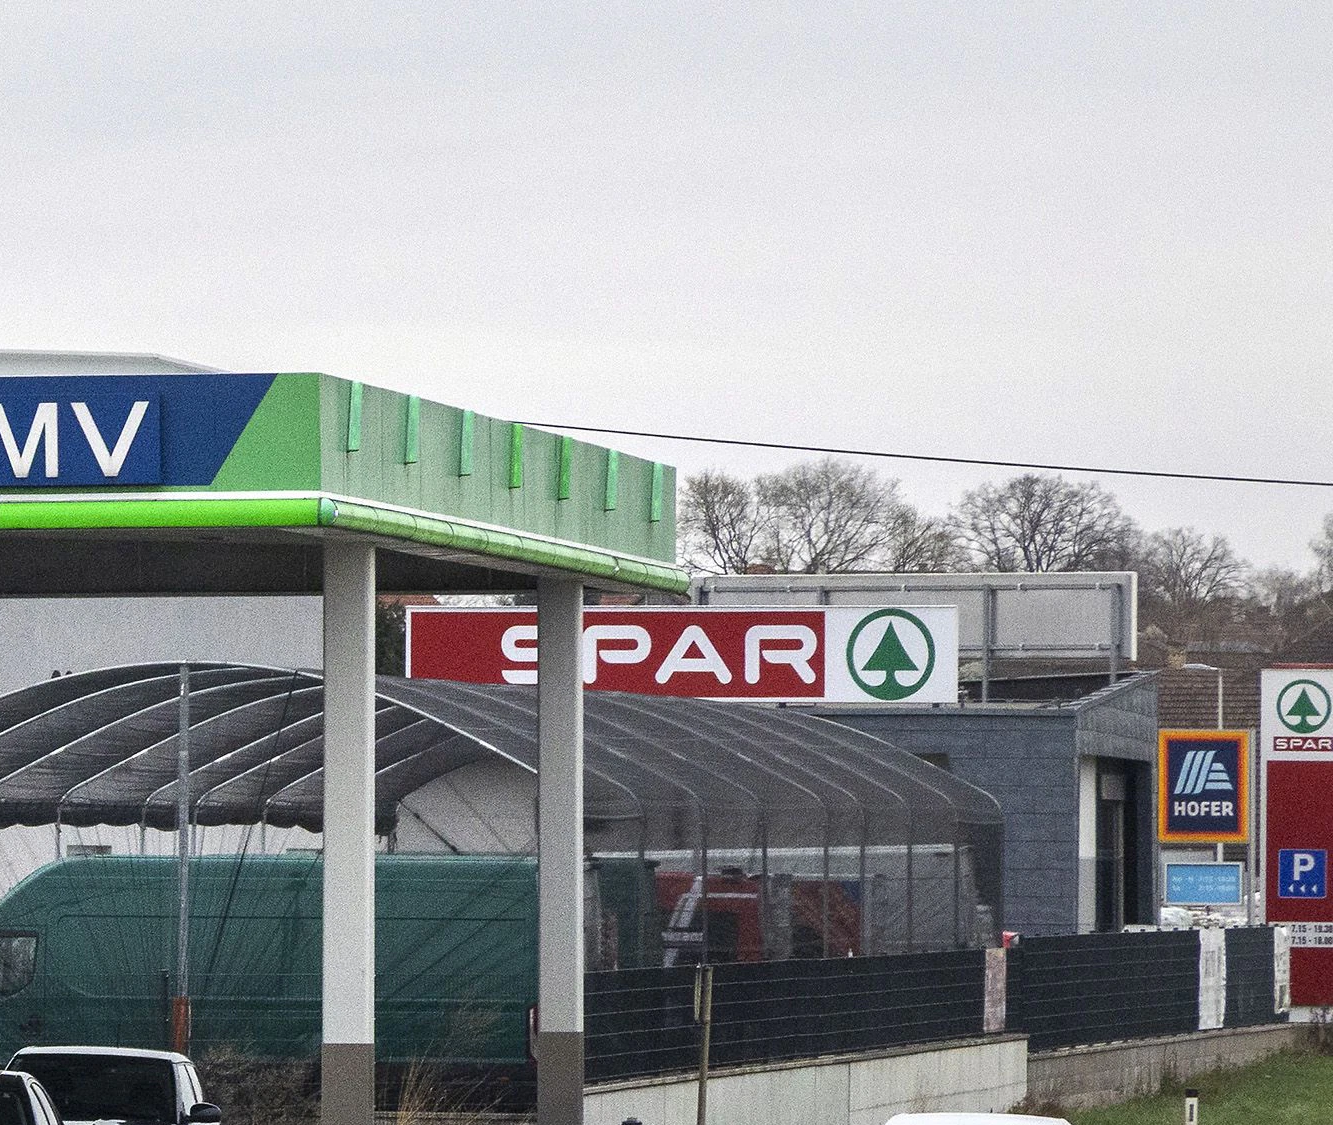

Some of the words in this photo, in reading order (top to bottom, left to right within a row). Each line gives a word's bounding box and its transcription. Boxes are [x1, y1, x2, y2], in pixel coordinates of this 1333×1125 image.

[1275, 738, 1333, 750] SPAR
[1173, 801, 1234, 817] HOFER
[1293, 853, 1316, 881] P
